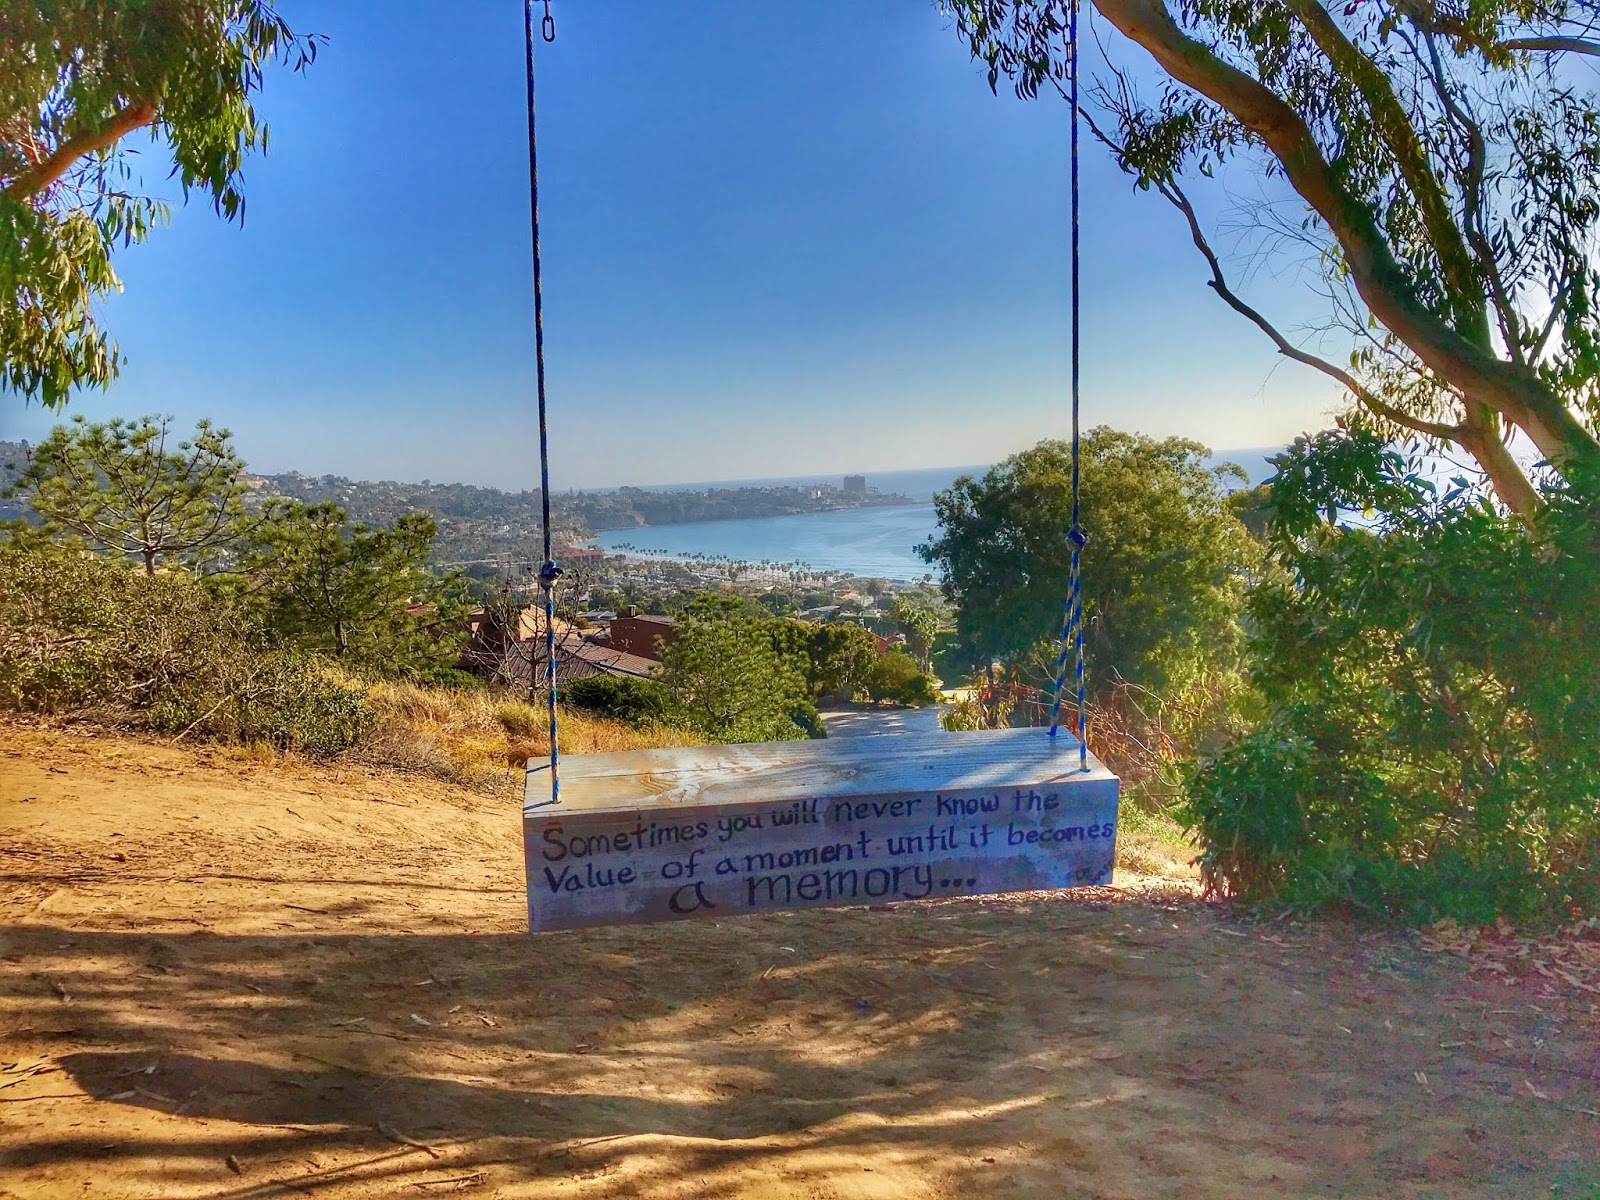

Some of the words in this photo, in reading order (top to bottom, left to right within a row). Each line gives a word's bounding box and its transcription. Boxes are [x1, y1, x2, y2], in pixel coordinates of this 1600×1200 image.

[542, 815, 708, 862] Sometimes
[717, 816, 762, 842] you
[772, 800, 818, 825] will
[833, 799, 922, 823] never
[936, 794, 999, 817] know
[1014, 790, 1060, 811] the
[543, 867, 637, 894] Value
[661, 849, 705, 879] of
[715, 856, 738, 875] a
[744, 831, 872, 872] moment
[887, 825, 956, 855] until
[969, 823, 994, 848] it
[1007, 822, 1115, 846] becomes
[669, 880, 716, 914] a
